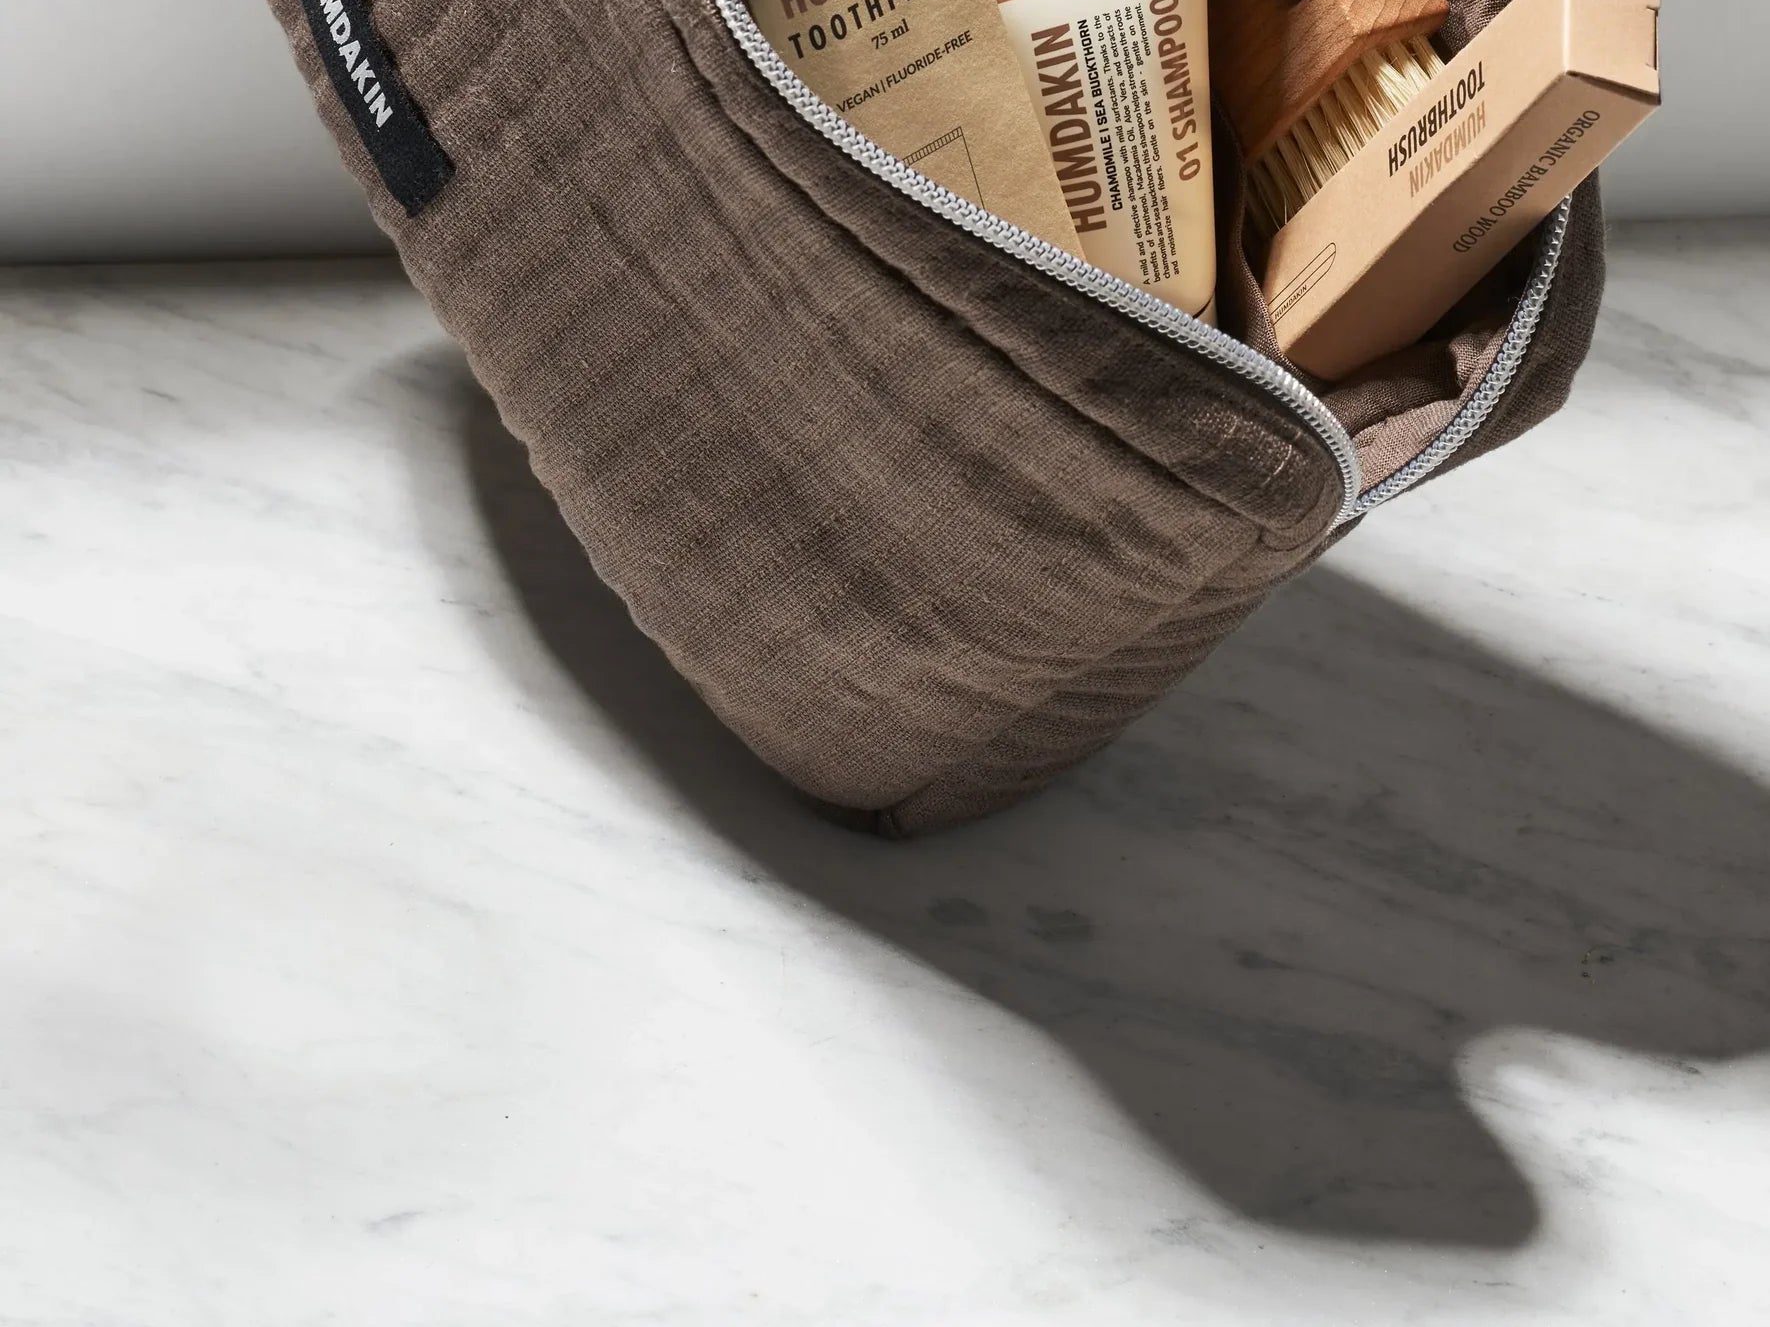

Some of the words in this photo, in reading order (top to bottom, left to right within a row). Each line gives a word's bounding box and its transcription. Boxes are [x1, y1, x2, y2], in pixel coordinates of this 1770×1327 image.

[1094, 15, 1102, 30] the
[1102, 12, 1111, 21] of
[1115, 9, 1124, 30] roots
[1124, 6, 1133, 21] the
[871, 32, 889, 50] 75
[892, 19, 910, 39] ml
[1098, 33, 1105, 42] to
[1107, 24, 1119, 58] extracts
[1119, 30, 1128, 45] the
[1129, 24, 1136, 36] on
[1134, 3, 1151, 56] environment.
[1077, 19, 1102, 98] BUCKTHORN
[1100, 44, 1111, 74] Thanks
[1132, 40, 1144, 66] gentle
[836, 83, 880, 113] VEGAN
[886, 30, 973, 88] FLUORIDE-FREE
[1113, 61, 1123, 76] and
[1123, 45, 1137, 90] strengthen
[1107, 75, 1122, 123] surfactants.
[1139, 79, 1149, 96] skin
[1094, 99, 1108, 125] SEA
[1123, 105, 1132, 123] Aloe
[1132, 90, 1142, 113] helps
[1144, 101, 1152, 115] the
[1031, 23, 1108, 233] HUMDAKIN
[1136, 112, 1148, 149] shampoo
[1147, 118, 1155, 130] on
[1388, 60, 1486, 177] TOOTHBRUSH
[1115, 125, 1125, 142] mild
[1539, 110, 1600, 166] ORGANIC
[1119, 145, 1129, 165] with
[1142, 149, 1151, 164] this
[1150, 135, 1160, 162] Gentle
[1175, 141, 1201, 181] 01
[1409, 101, 1487, 199] HUMDAKIN
[1100, 135, 1123, 211] CHAMOMILE
[1129, 145, 1145, 191] Macadamia
[1158, 165, 1167, 191] fibers.
[1124, 167, 1136, 202] shampoo
[1489, 165, 1549, 217] BAMBOO
[1153, 207, 1161, 221] sea
[1162, 195, 1170, 212] hair
[1131, 204, 1143, 239] effective
[1153, 221, 1164, 236] and
[1452, 216, 1497, 253] WOOD
[1146, 239, 1155, 248] of
[1165, 215, 1177, 256] moisturize
[1136, 242, 1146, 256] and
[1157, 236, 1171, 279] chamomile
[1139, 259, 1149, 276] mild
[1149, 250, 1160, 283] benefits
[1171, 260, 1180, 275] and
[1274, 284, 1307, 319] HUMDAKIN
